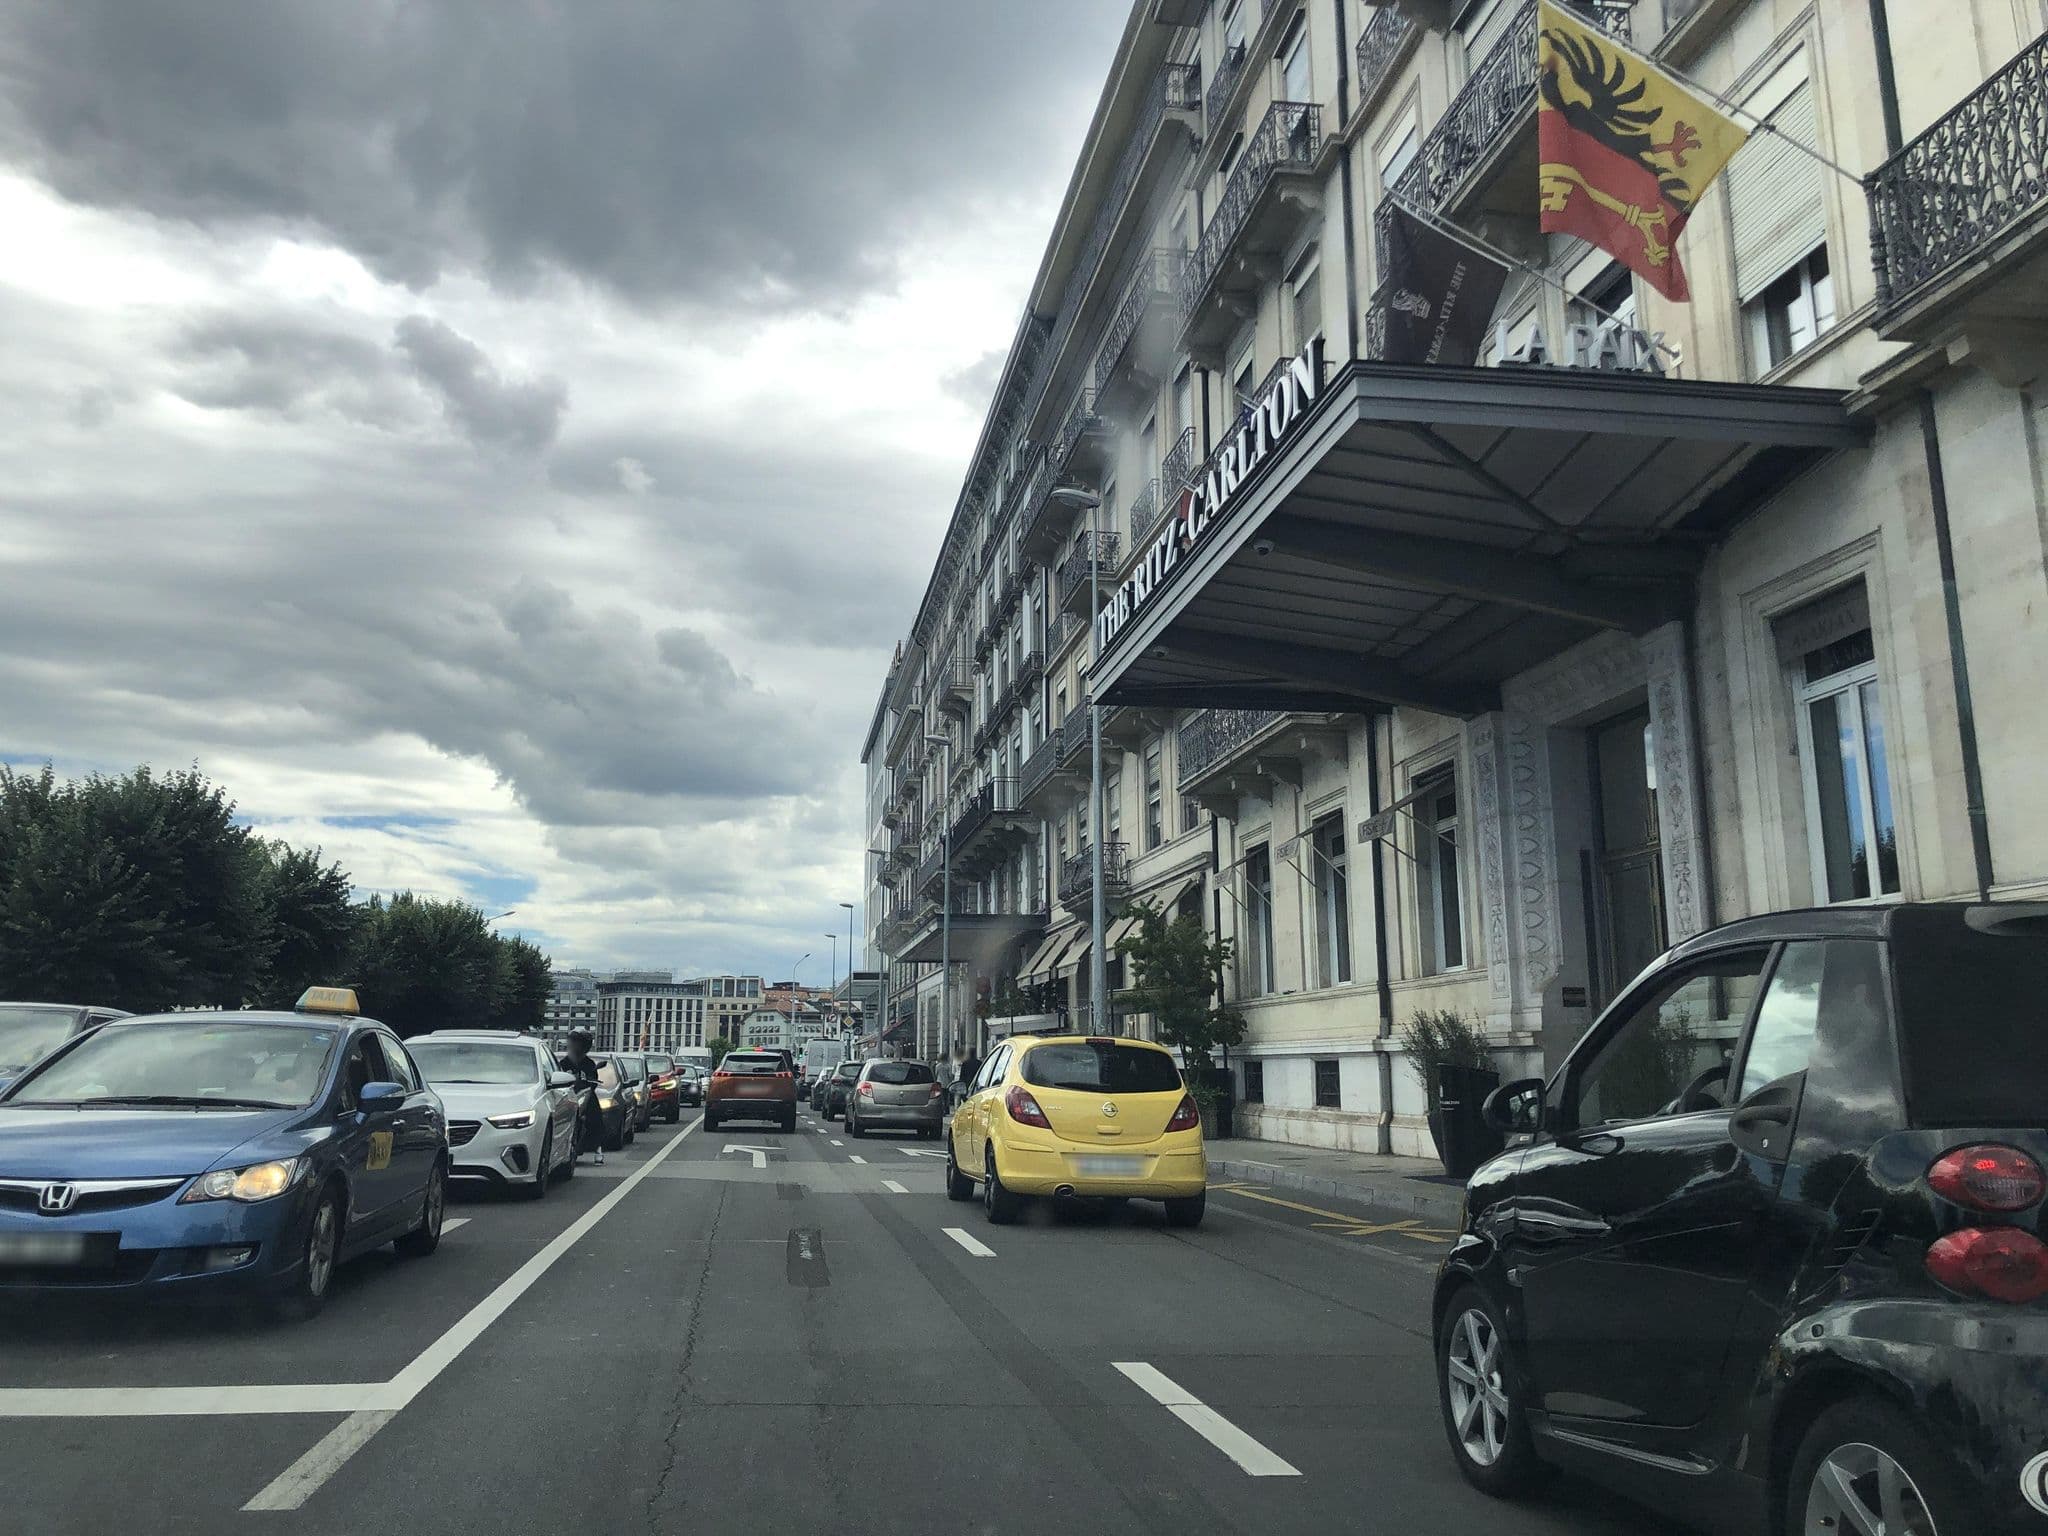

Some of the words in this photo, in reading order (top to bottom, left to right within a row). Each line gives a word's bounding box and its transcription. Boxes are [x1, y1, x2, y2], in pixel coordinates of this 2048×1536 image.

[1495, 319, 1553, 364] LA
[1567, 323, 1666, 375] PAIX
[1098, 580, 1130, 652] THE
[1132, 335, 1316, 611] RITZ-CARLTON
